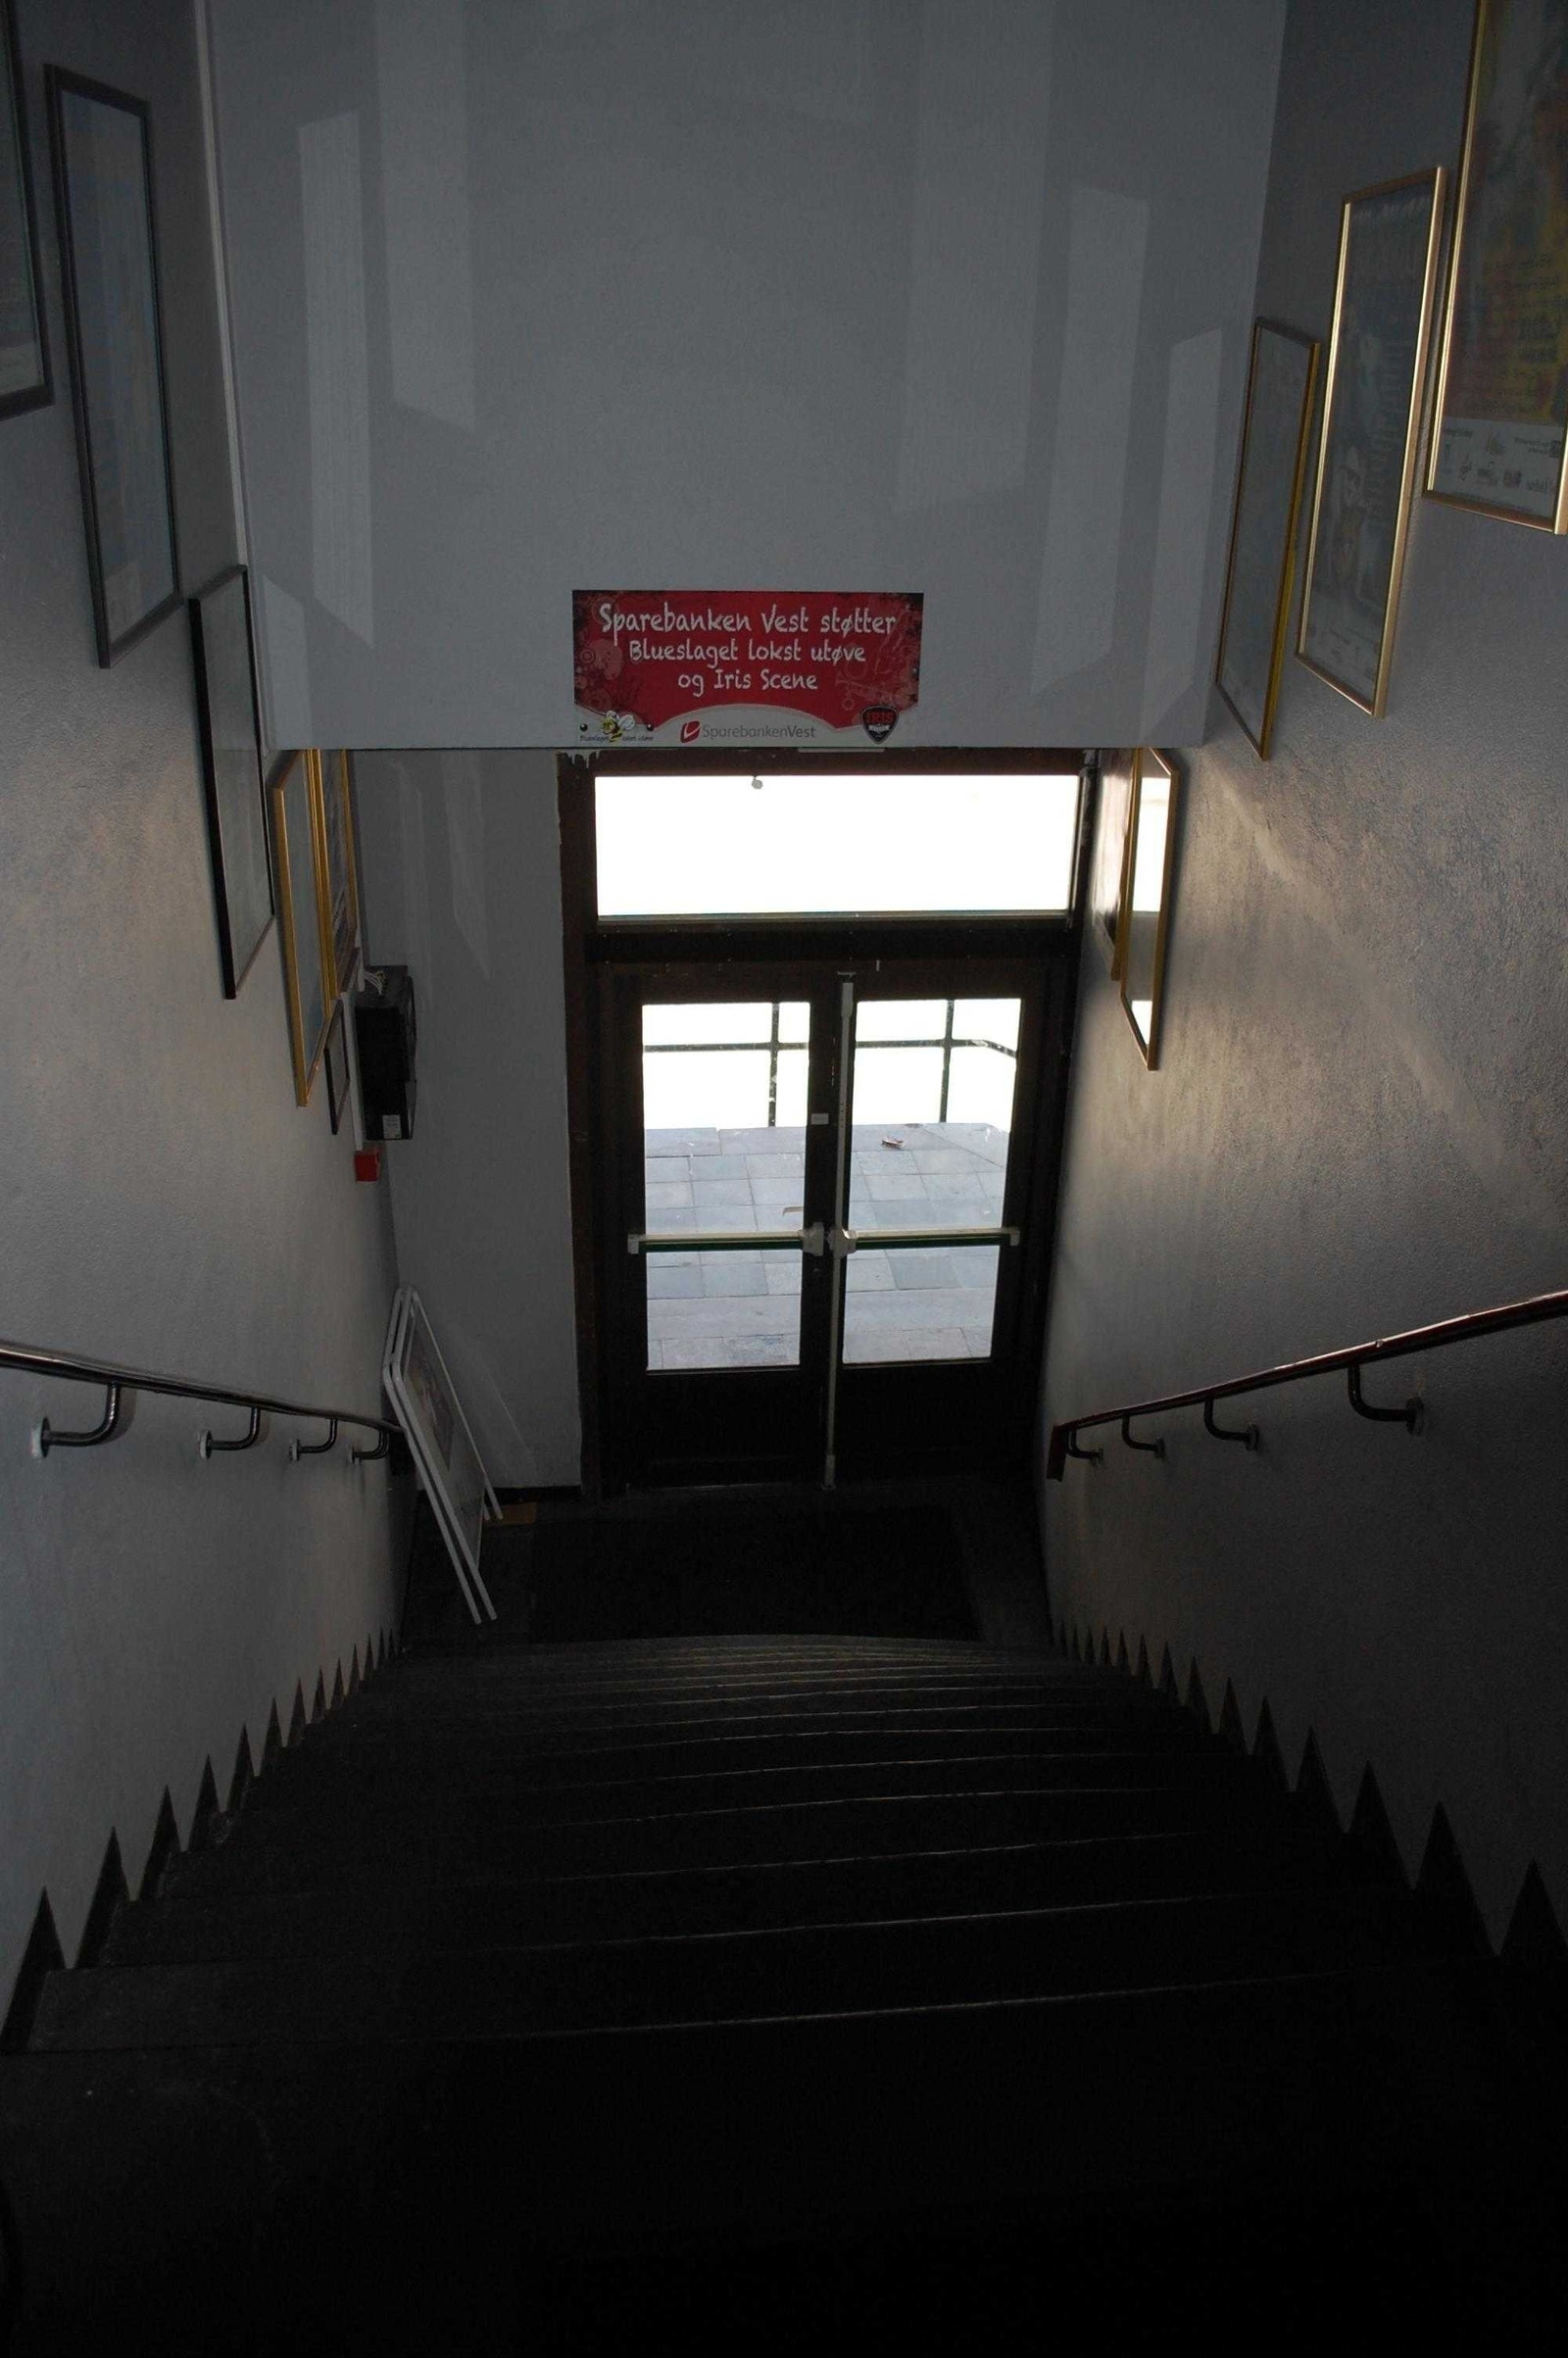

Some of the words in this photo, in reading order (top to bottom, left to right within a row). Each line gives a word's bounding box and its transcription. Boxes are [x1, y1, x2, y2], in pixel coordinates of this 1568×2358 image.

[599, 603, 752, 645] Sparebanken
[761, 604, 809, 633] Vest
[819, 607, 897, 638] støtter
[629, 638, 739, 668] Blueslaget
[749, 638, 802, 661] lokst
[810, 641, 866, 665] utøve
[677, 674, 705, 698] og
[713, 669, 752, 690] Iris
[760, 669, 818, 690] Scene
[703, 723, 816, 743] SparebankenVest
